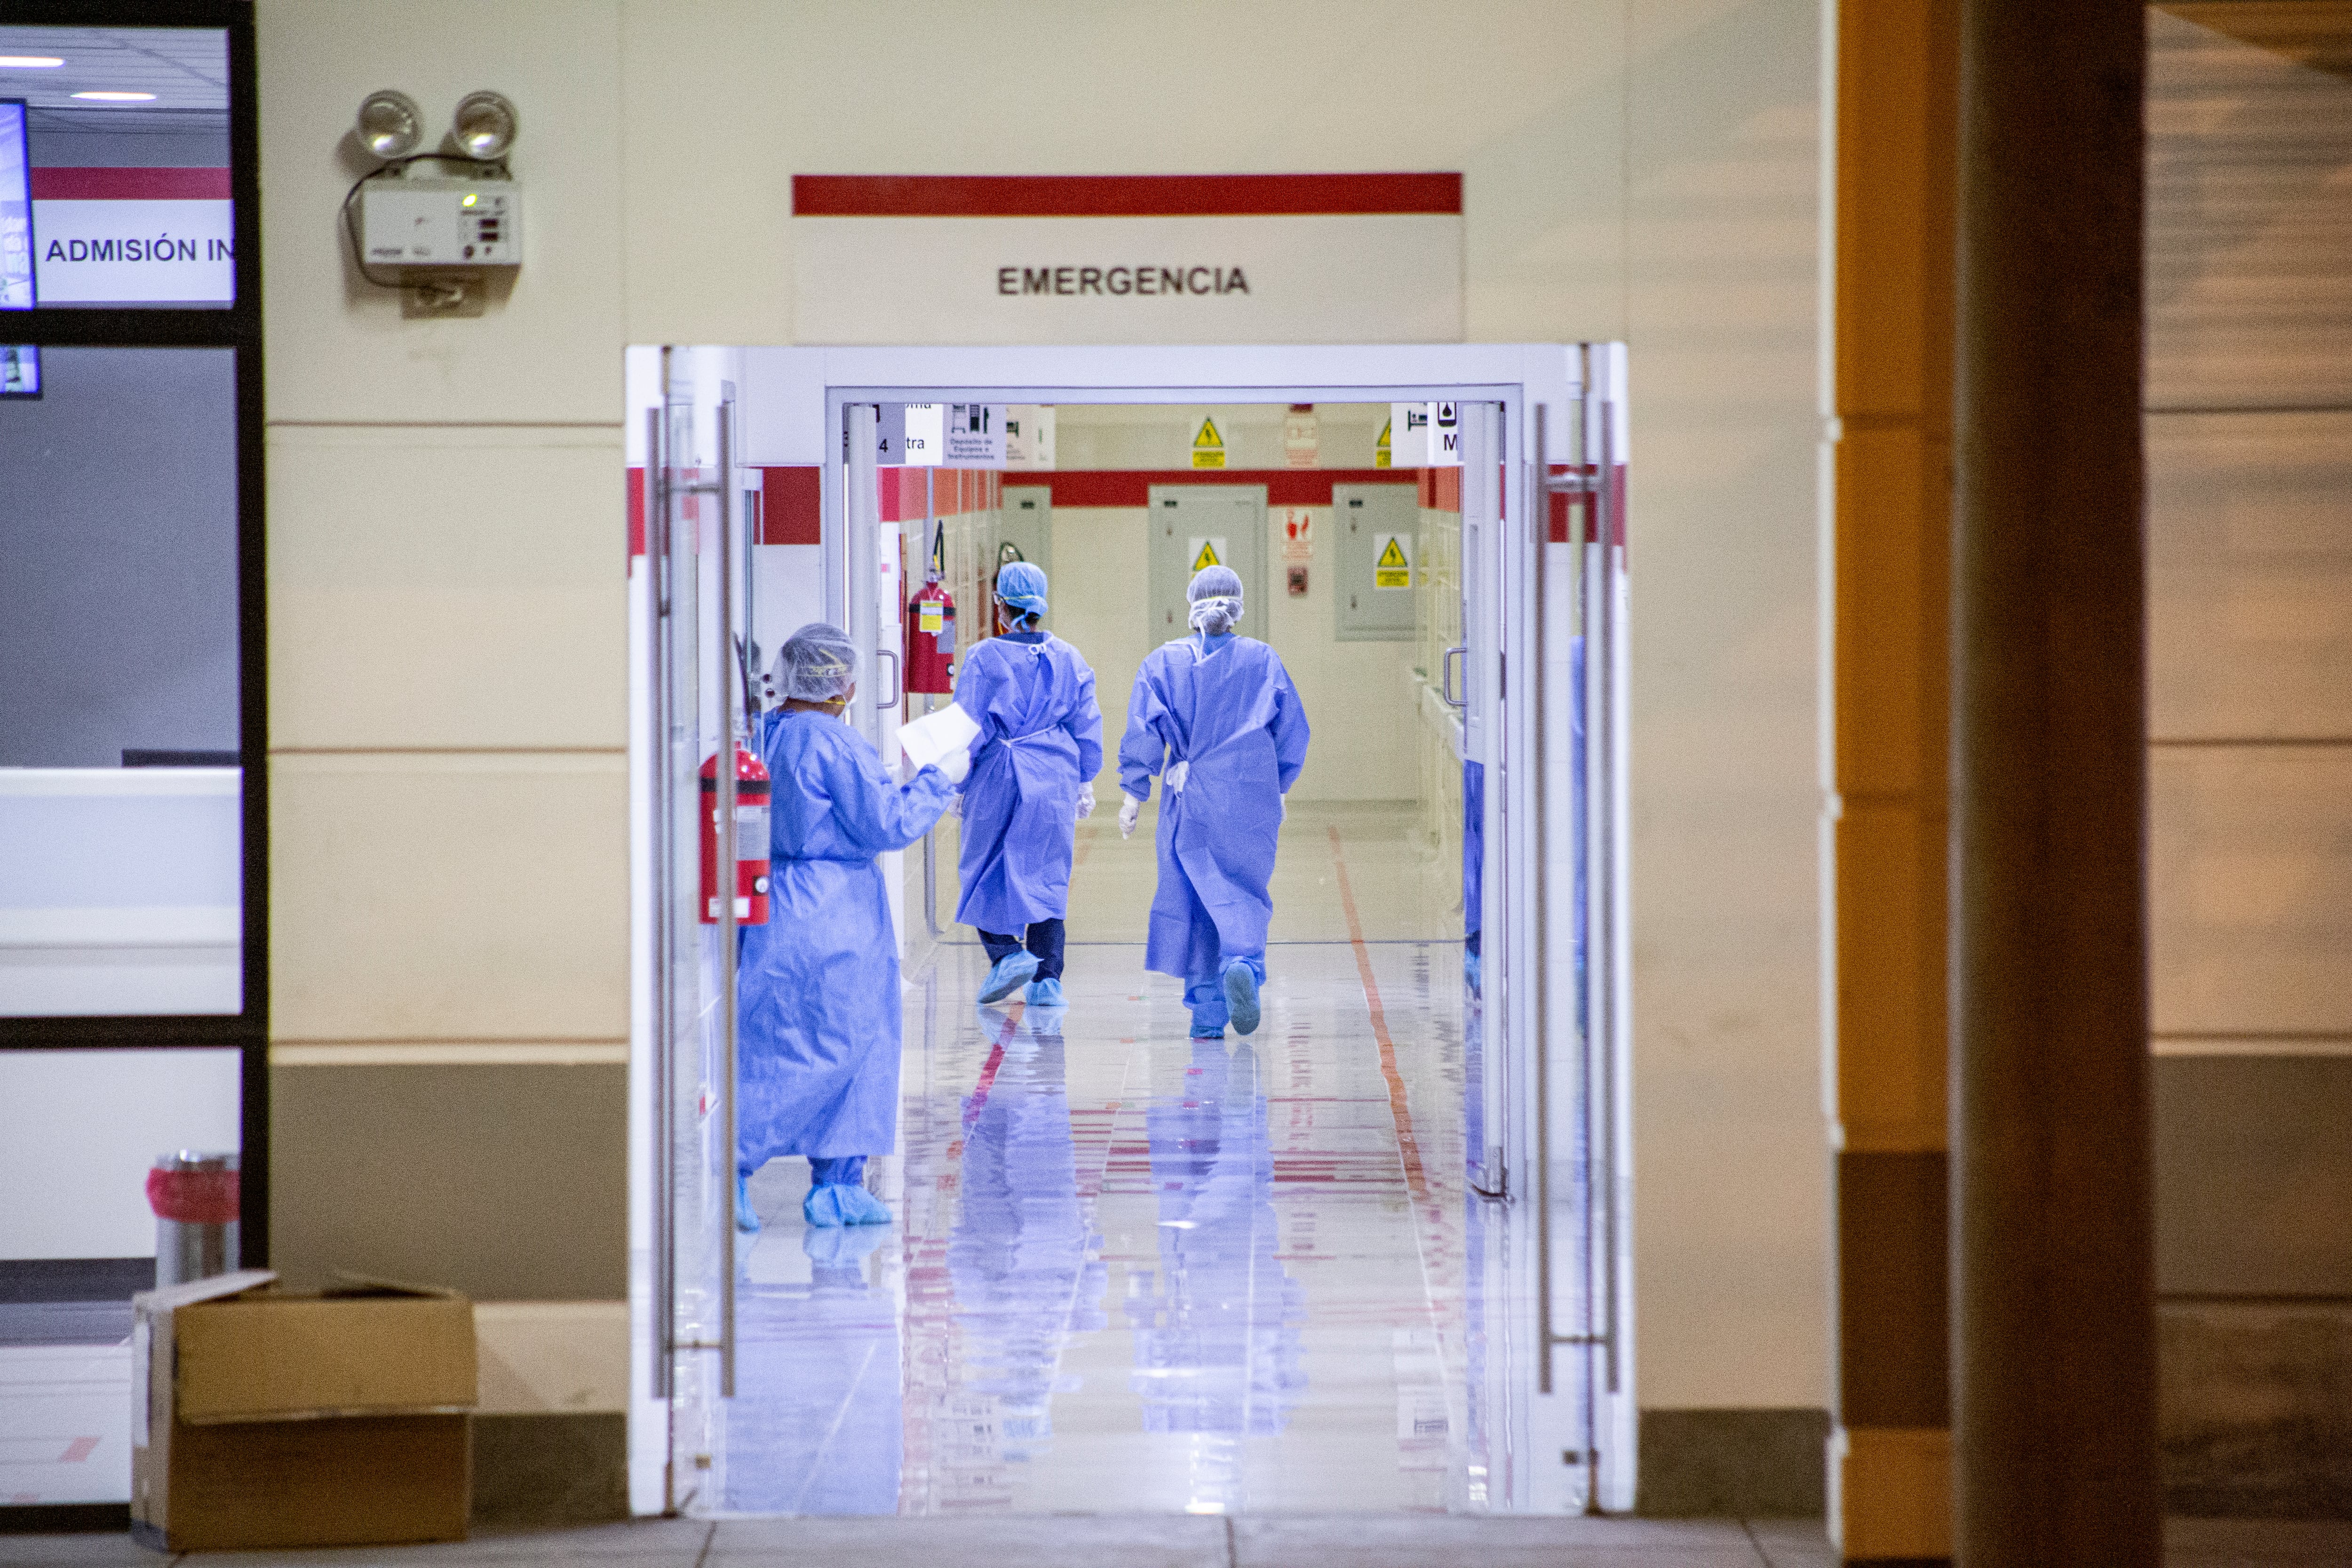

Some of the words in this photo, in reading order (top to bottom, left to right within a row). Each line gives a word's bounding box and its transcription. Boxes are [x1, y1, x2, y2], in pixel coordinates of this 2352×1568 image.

[45, 232, 196, 262] ADMISIÓN
[997, 267, 1250, 295] EMERGENCIA
[879, 438, 889, 453] 4
